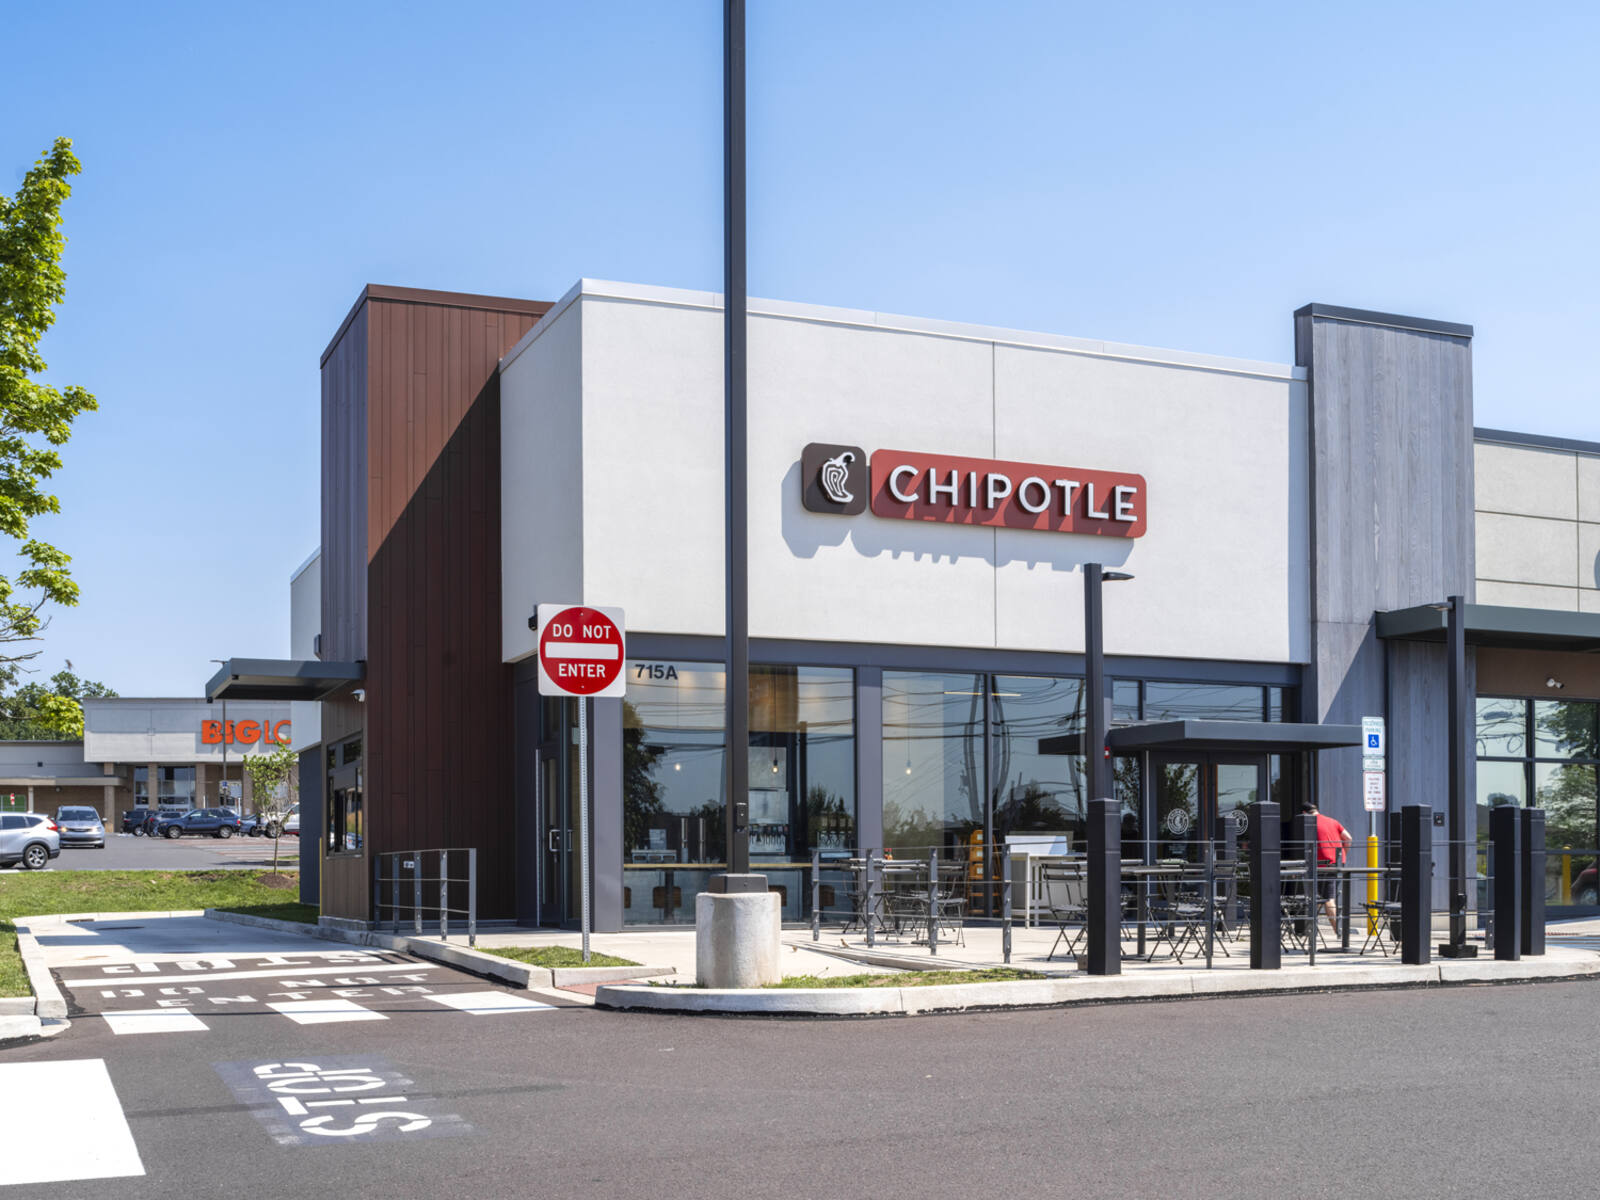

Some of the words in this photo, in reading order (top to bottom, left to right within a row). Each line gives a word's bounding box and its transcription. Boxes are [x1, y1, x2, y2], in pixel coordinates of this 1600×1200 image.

[888, 464, 1138, 522] CHIPOTLE
[552, 624, 573, 638] DO
[583, 625, 611, 639] NOT
[558, 663, 606, 678] ENTER
[634, 664, 678, 680] 715A
[201, 720, 262, 744] BIG
[100, 986, 206, 999] DO
[278, 973, 429, 988] NOT
[156, 986, 434, 1008] ENTER
[252, 1062, 433, 1137] STOP
